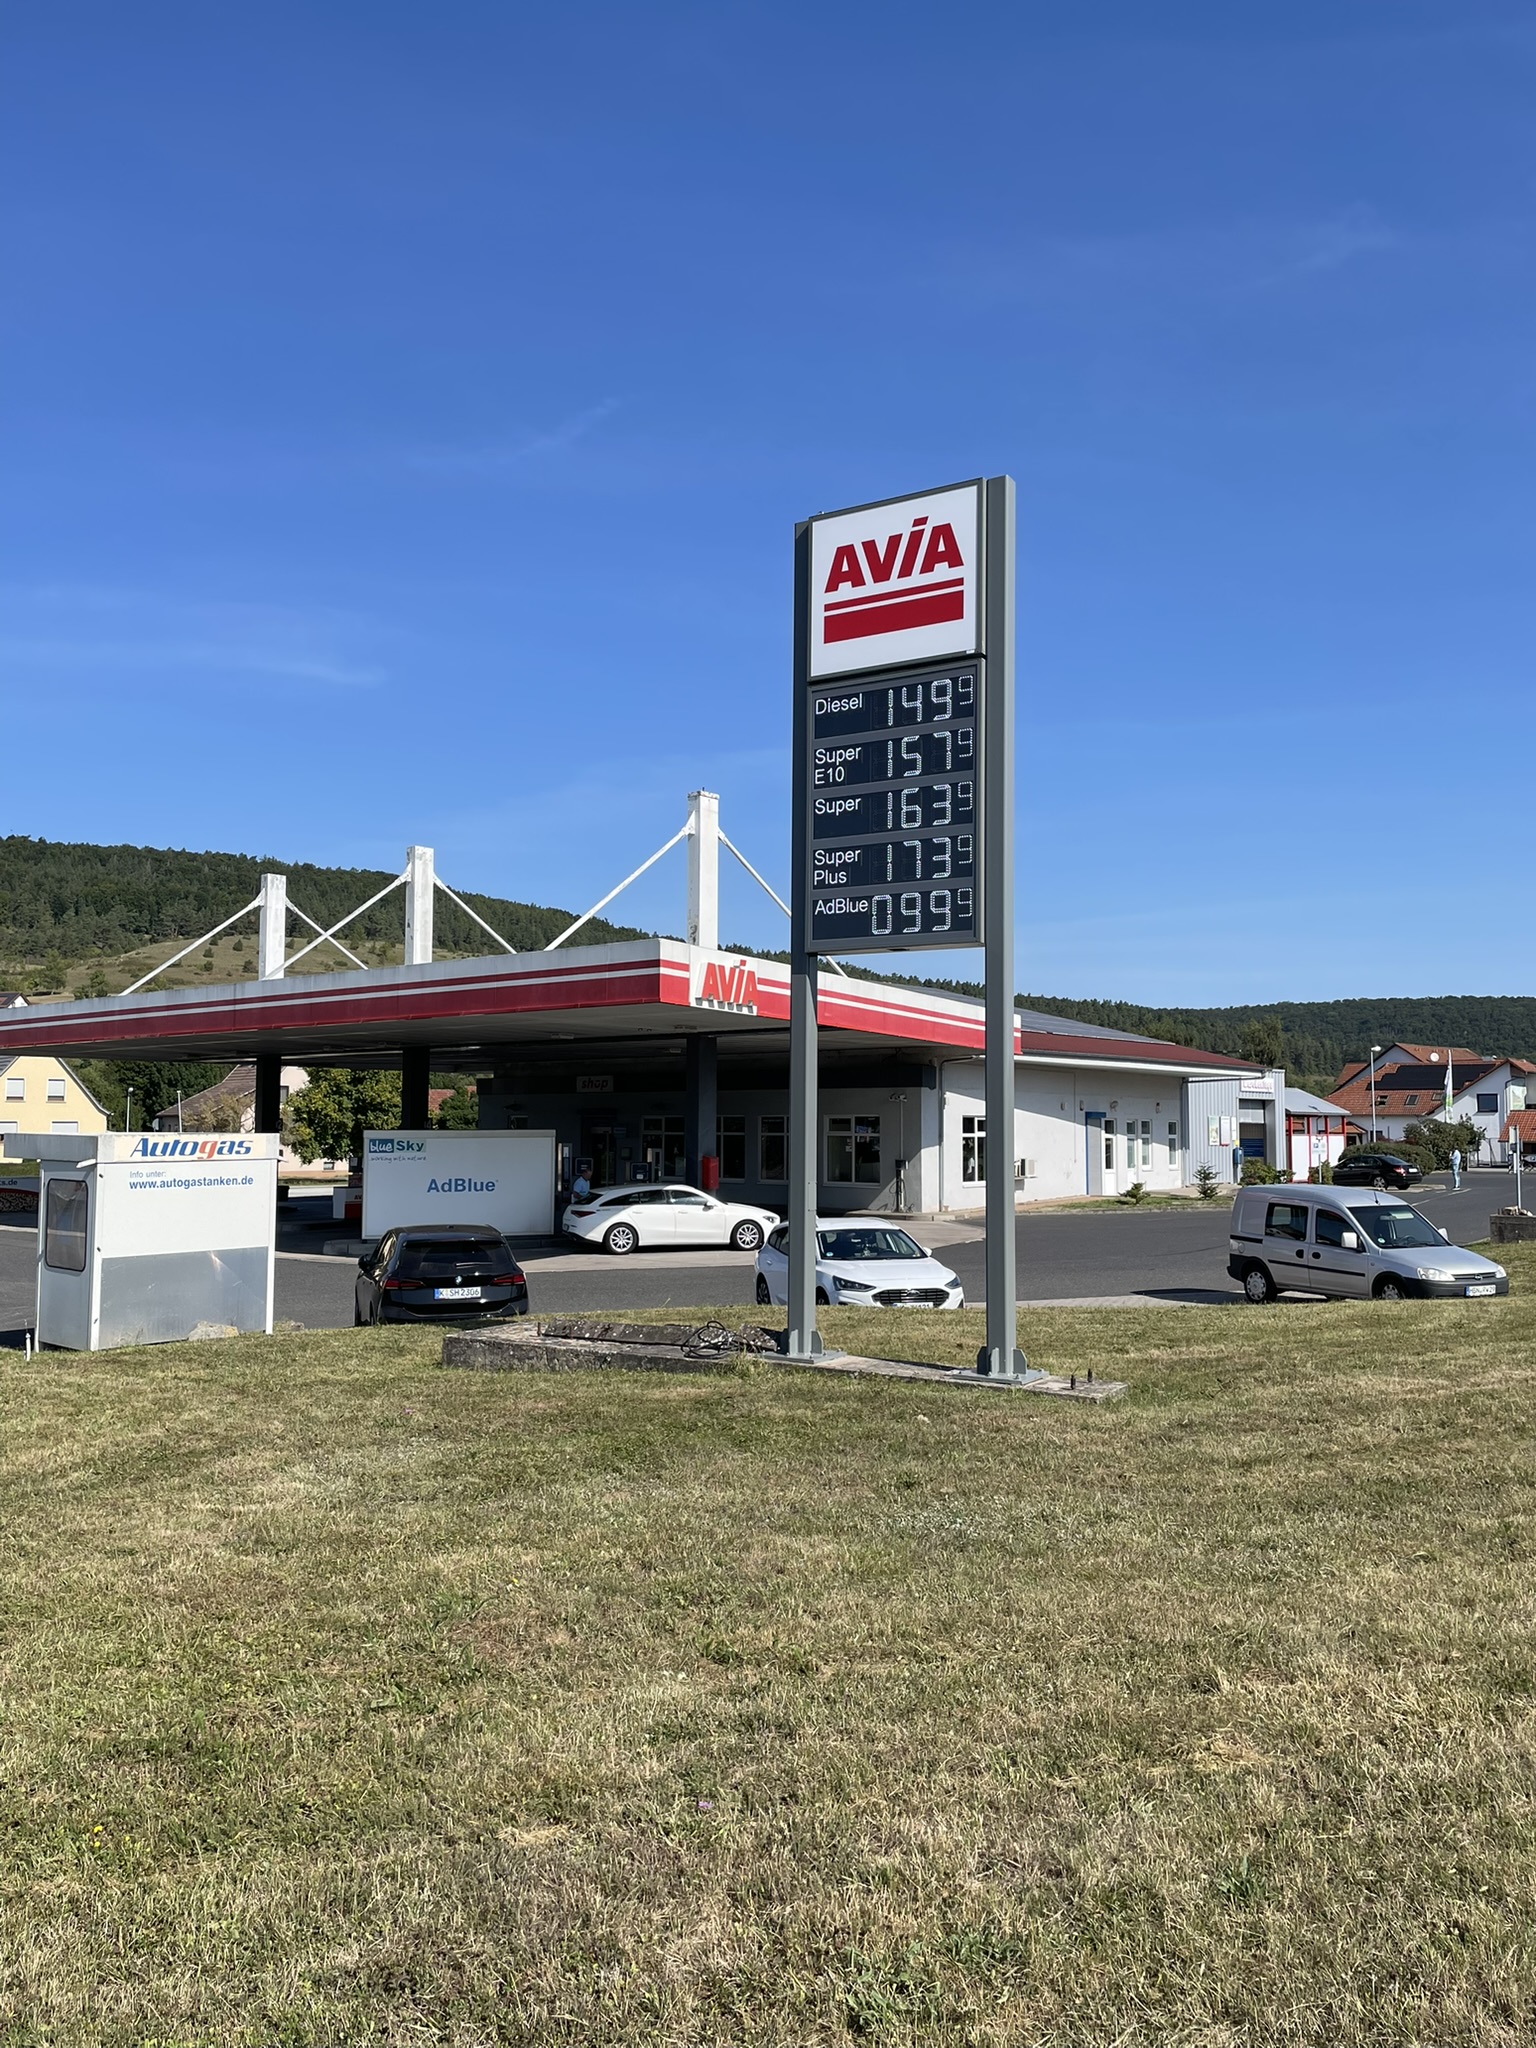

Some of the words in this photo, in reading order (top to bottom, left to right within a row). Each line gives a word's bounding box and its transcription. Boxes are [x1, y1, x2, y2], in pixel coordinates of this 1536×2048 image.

[824, 516, 964, 594] AVIA
[815, 693, 863, 715] Diesel
[815, 745, 861, 766] Super
[815, 766, 845, 784] E10
[815, 797, 861, 816] Super
[815, 848, 861, 867] Super
[814, 870, 847, 886] Plus
[814, 898, 869, 916] AdBlue
[701, 959, 758, 1007] AVIA
[582, 1077, 608, 1091] shop
[130, 1137, 254, 1160] Autogas
[129, 1171, 143, 1179] Info
[145, 1170, 167, 1178] unter:
[129, 1176, 254, 1189] www.autogastanken.de
